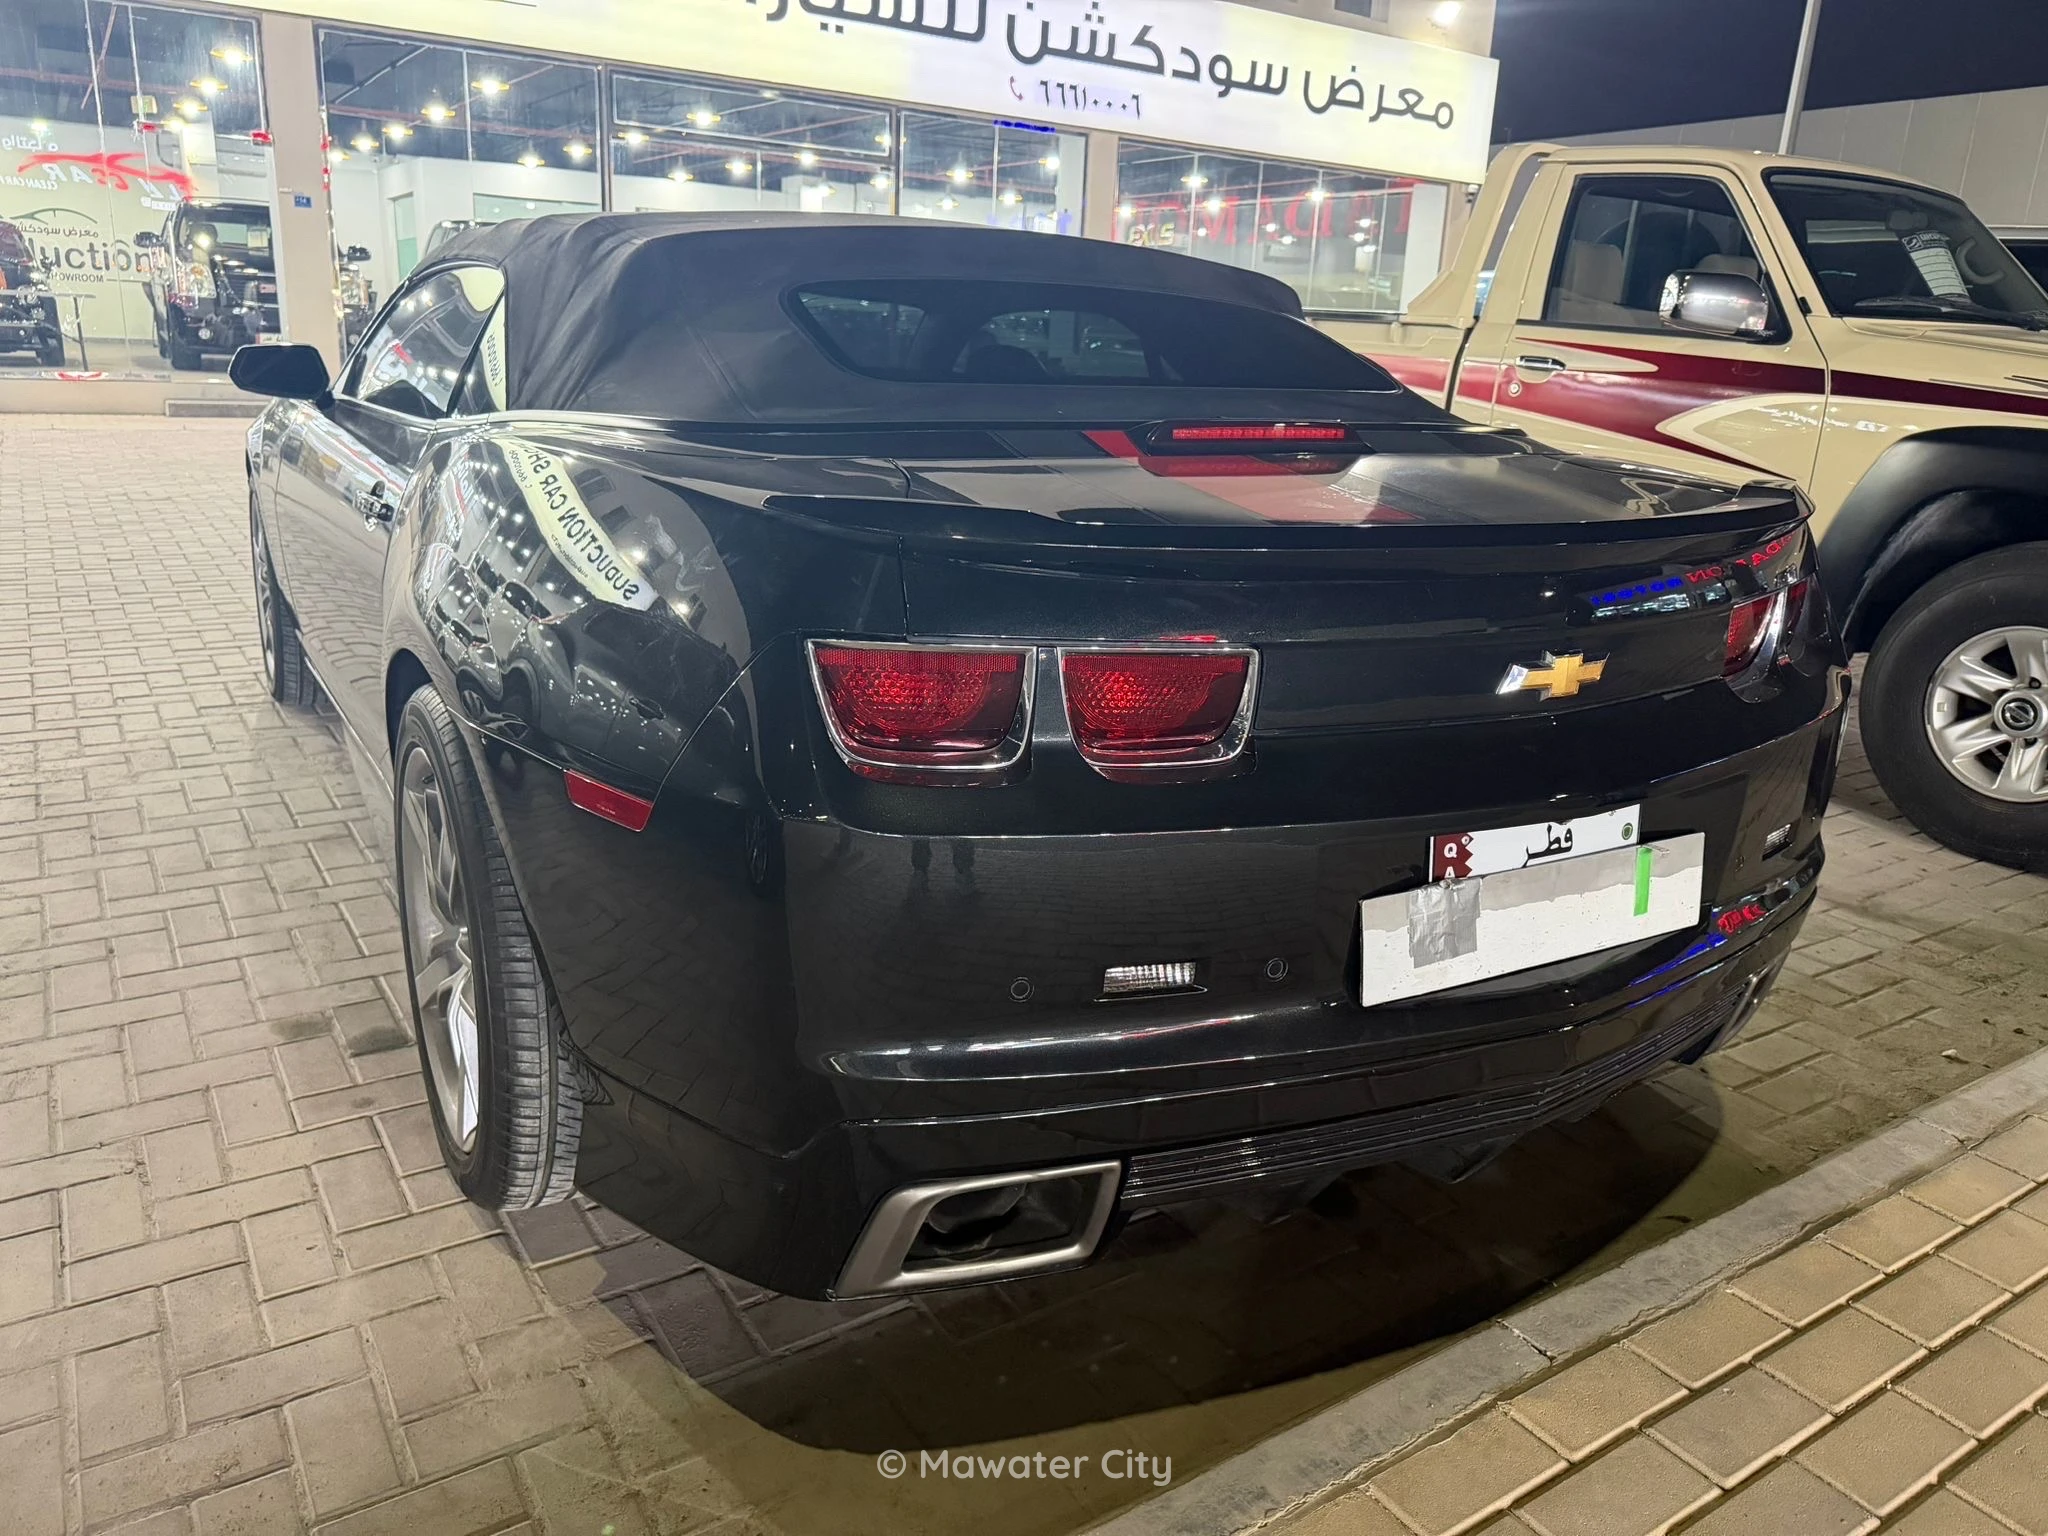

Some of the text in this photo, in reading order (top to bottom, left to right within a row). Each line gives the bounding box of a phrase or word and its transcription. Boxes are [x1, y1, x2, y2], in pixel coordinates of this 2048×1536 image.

[1006, 1, 1289, 98] سودكشن
[1039, 79, 1142, 120] ٦٦٦١٠٠٠٦
[1303, 64, 1454, 130] معرض
[1521, 824, 1574, 869] قطر
